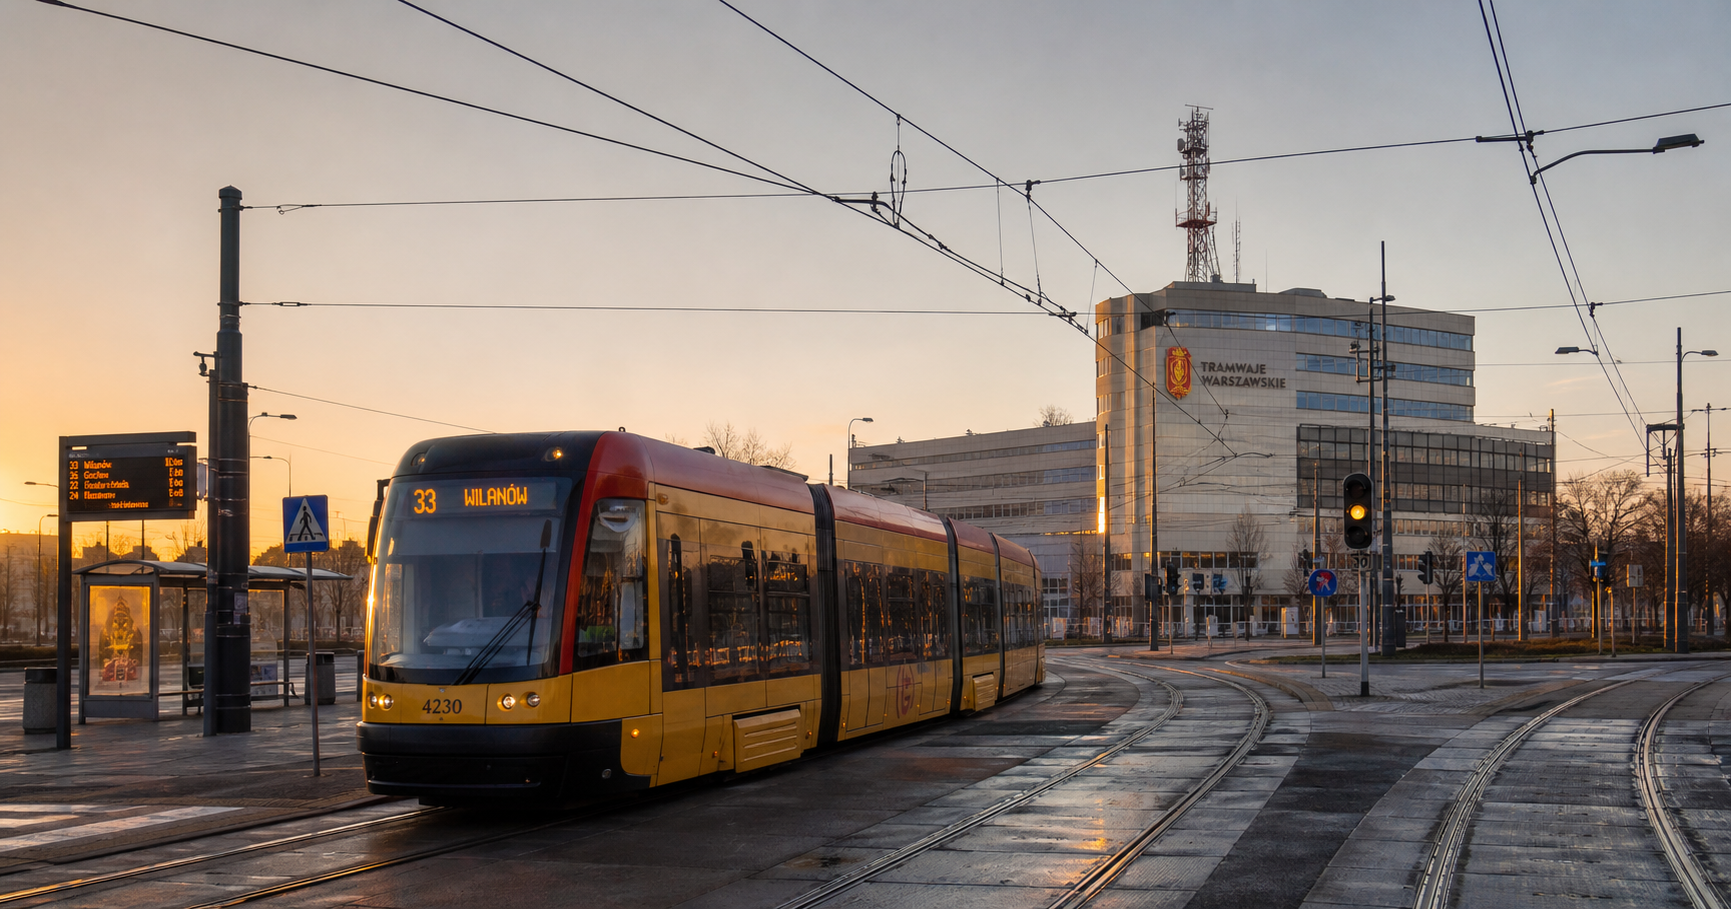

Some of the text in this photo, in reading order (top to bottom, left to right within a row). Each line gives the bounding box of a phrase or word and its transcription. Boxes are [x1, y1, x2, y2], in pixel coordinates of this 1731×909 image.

[1200, 361, 1266, 374] TRAMWAJE
[1201, 375, 1286, 389] WARSZAWSKIE
[413, 484, 528, 514] 33 WILANÓW
[422, 699, 462, 714] 4230
